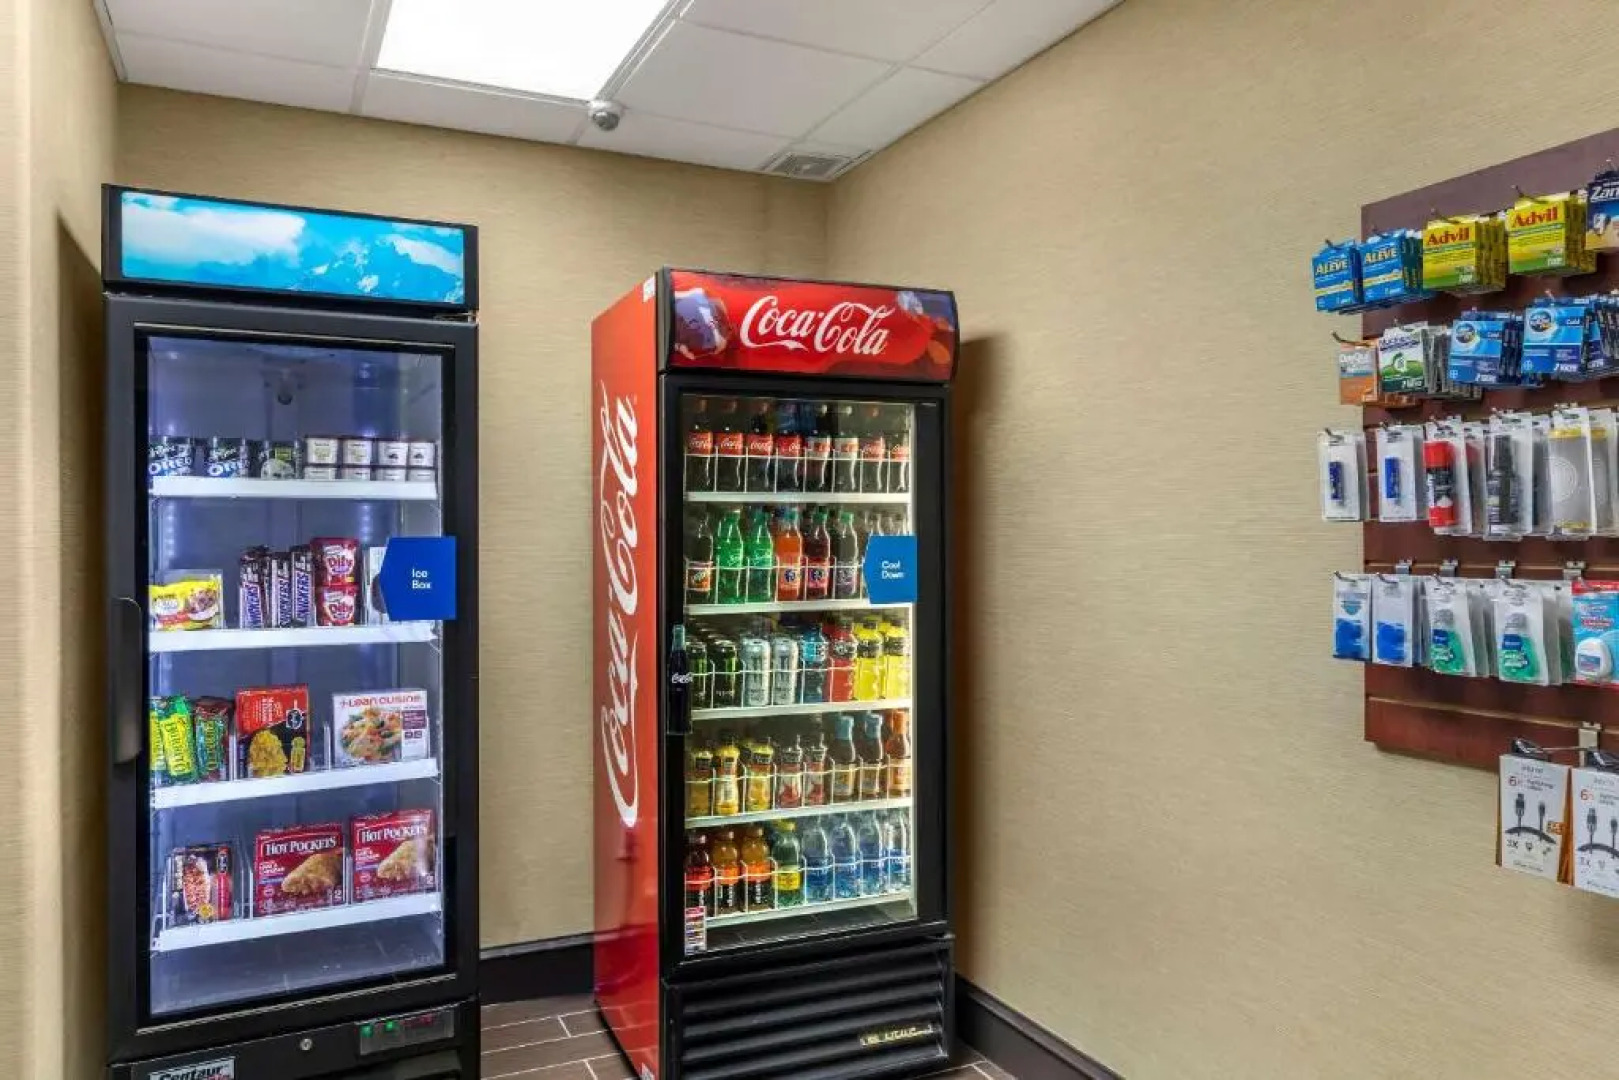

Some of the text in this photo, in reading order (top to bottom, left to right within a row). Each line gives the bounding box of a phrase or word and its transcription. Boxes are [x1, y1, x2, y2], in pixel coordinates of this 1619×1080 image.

[1512, 206, 1558, 228] Advil
[1427, 227, 1470, 247] Advil
[1364, 247, 1397, 264] ALEVE
[1316, 260, 1348, 275] ALEVE
[740, 295, 896, 355] Coca-Cola
[412, 568, 428, 578] Ice
[881, 560, 901, 570] Cool
[881, 570, 905, 580] Down
[412, 580, 432, 589] Box
[597, 379, 638, 829] Coca-Cola
